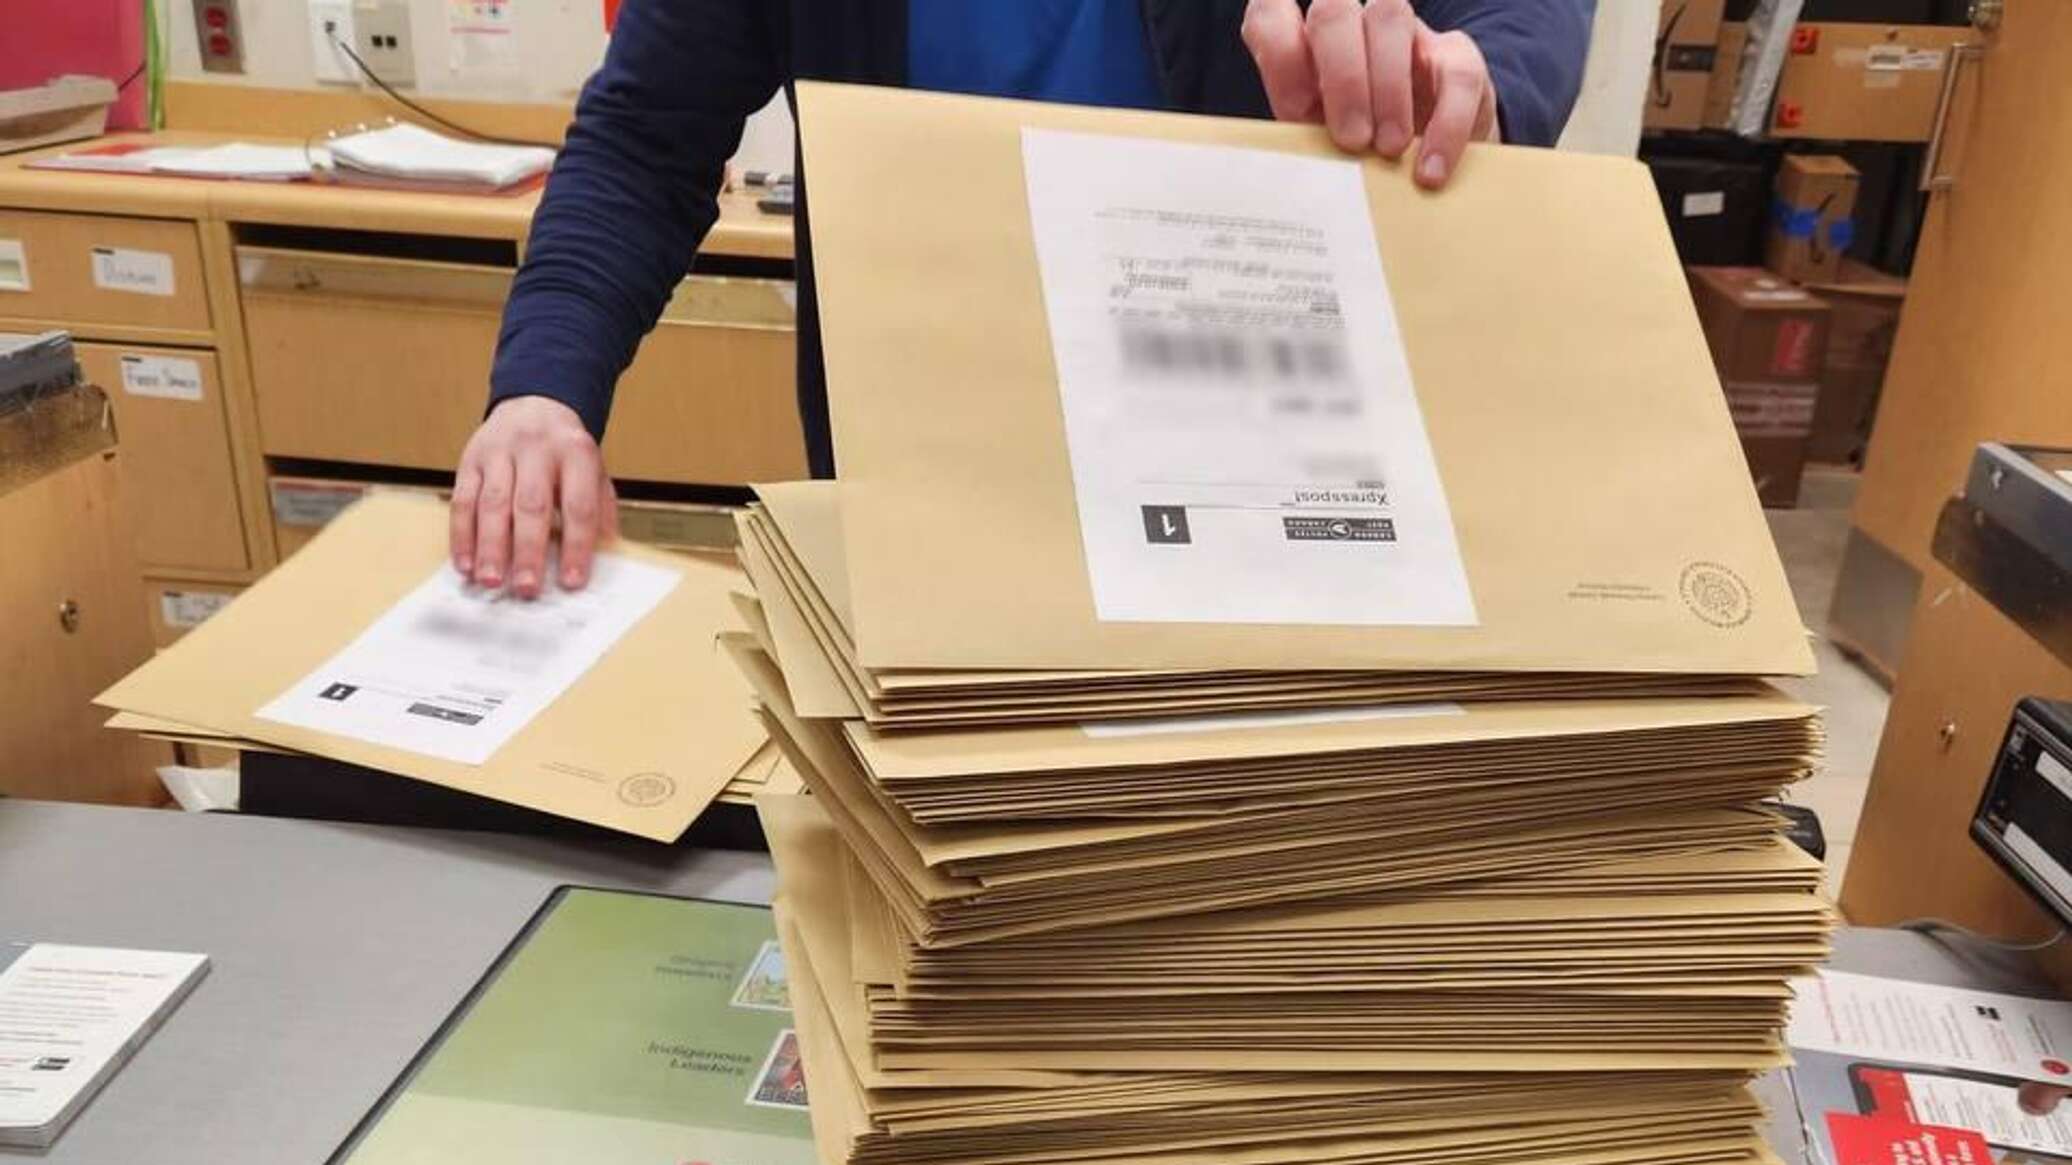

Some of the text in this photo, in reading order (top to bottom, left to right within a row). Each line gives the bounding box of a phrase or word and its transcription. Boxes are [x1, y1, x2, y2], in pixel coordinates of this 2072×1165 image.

[1294, 490, 1390, 506] Xpresspost
[1161, 513, 1176, 537] 1
[648, 1040, 752, 1063] Indigenous
[670, 1057, 745, 1076] Leaders
